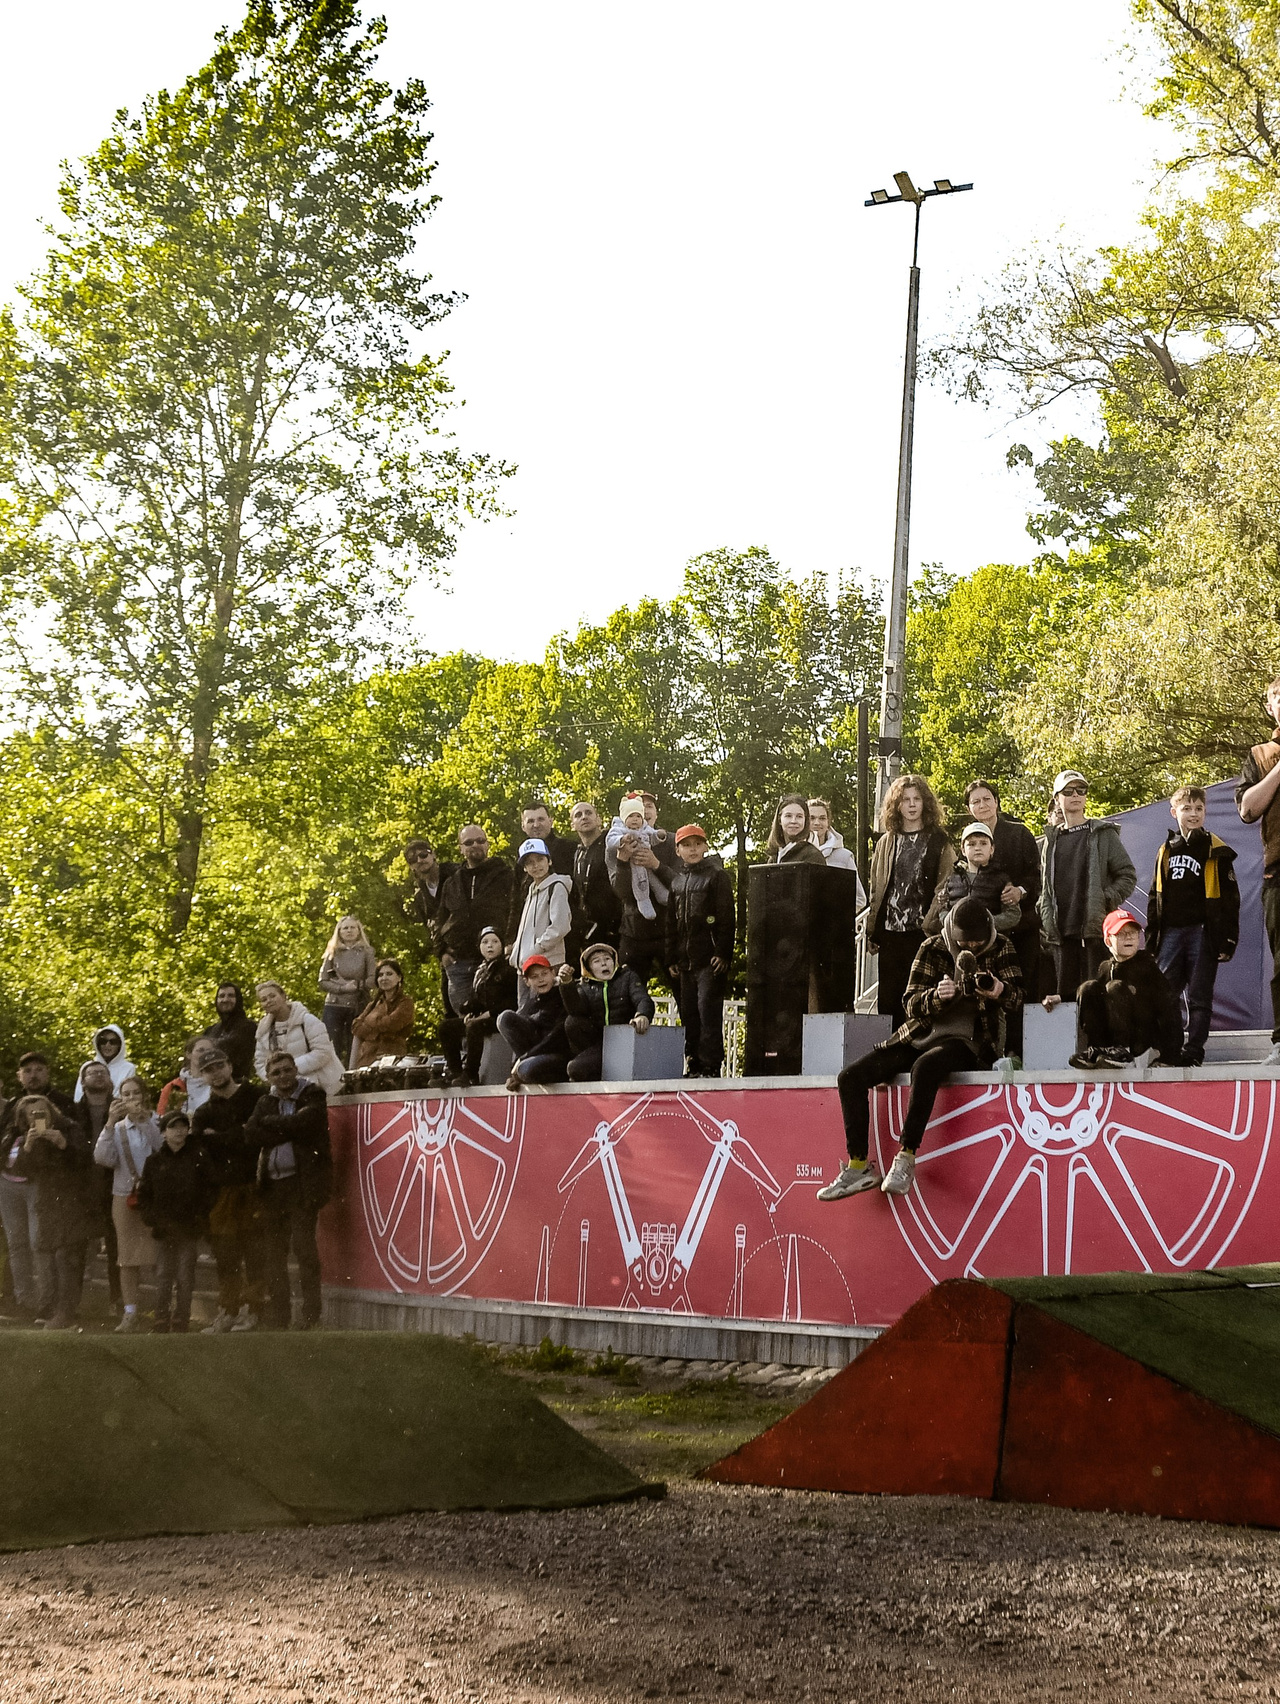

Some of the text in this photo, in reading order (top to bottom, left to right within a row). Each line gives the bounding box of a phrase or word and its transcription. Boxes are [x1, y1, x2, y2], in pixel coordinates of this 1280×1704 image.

[1169, 855, 1201, 876] HLETIC
[1172, 868, 1185, 880] 23
[796, 1164, 809, 1177] 535
